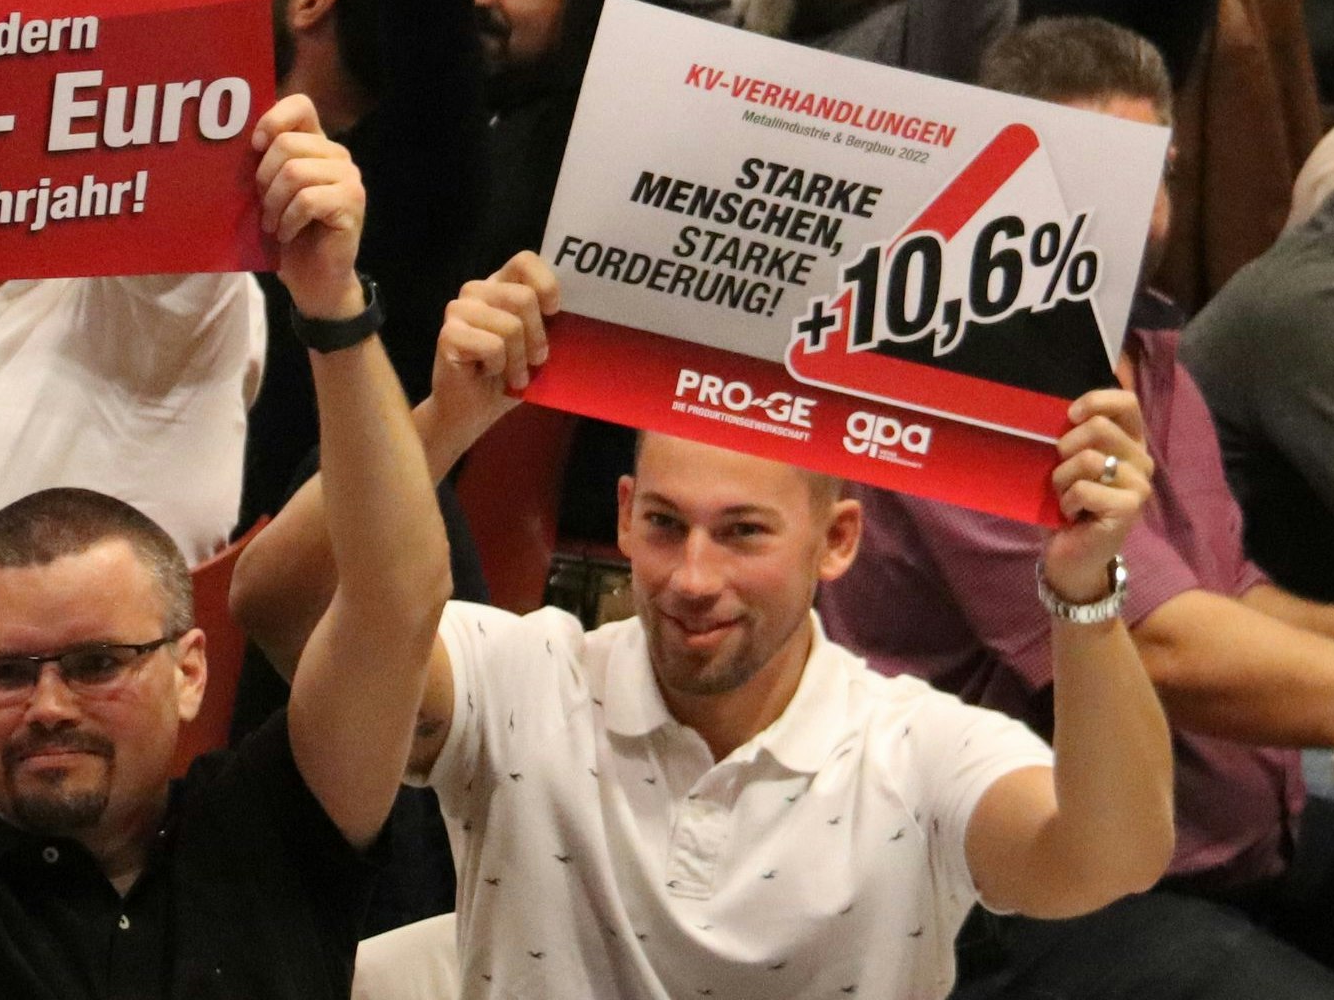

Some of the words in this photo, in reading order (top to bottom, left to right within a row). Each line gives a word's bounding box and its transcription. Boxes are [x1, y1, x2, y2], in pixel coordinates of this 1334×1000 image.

[47, 69, 252, 152] Euro
[685, 63, 957, 149] KV-VERHANDLUNGEN
[741, 109, 831, 144] Metallindustrie
[832, 131, 843, 144] &
[844, 133, 896, 158] Bergbau
[898, 145, 931, 164] 2022
[630, 170, 845, 258] MENSCHEN,
[735, 156, 883, 220] STARKE
[554, 235, 785, 318] FORDERUNG!
[672, 225, 818, 288] STARKE
[797, 213, 1098, 350] +10,6%
[674, 368, 819, 429] PRO-GE
[842, 410, 932, 458] gpa
